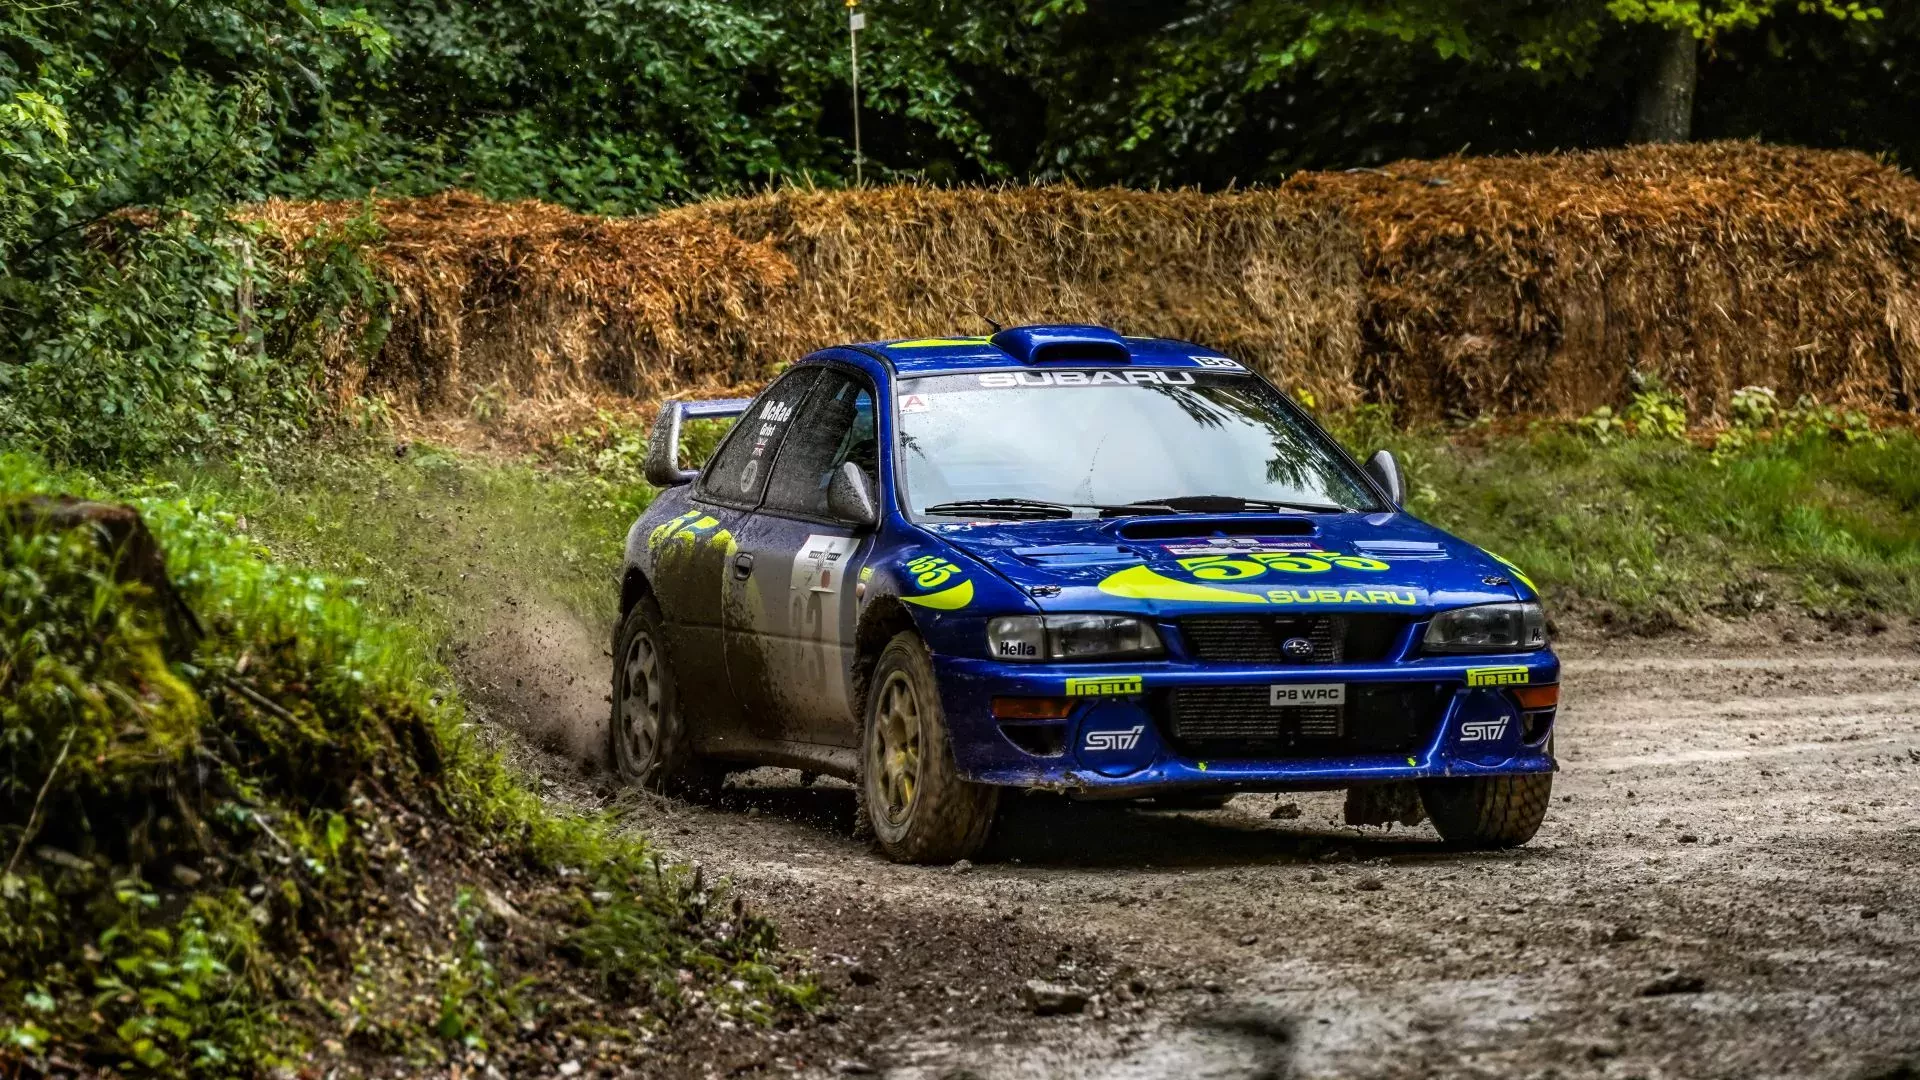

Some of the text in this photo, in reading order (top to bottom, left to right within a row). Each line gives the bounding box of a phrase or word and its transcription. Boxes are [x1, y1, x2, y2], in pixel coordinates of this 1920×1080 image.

[979, 371, 1196, 387] SUBARU
[759, 400, 792, 423] McRae
[906, 555, 962, 587] 555
[1176, 552, 1390, 580] 555
[1266, 590, 1417, 606] SUBARU
[1000, 641, 1037, 656] Hella
[1065, 675, 1143, 696] PIRELLI
[1466, 665, 1529, 687] PIRELLI
[1276, 688, 1340, 701] P8 WRC
